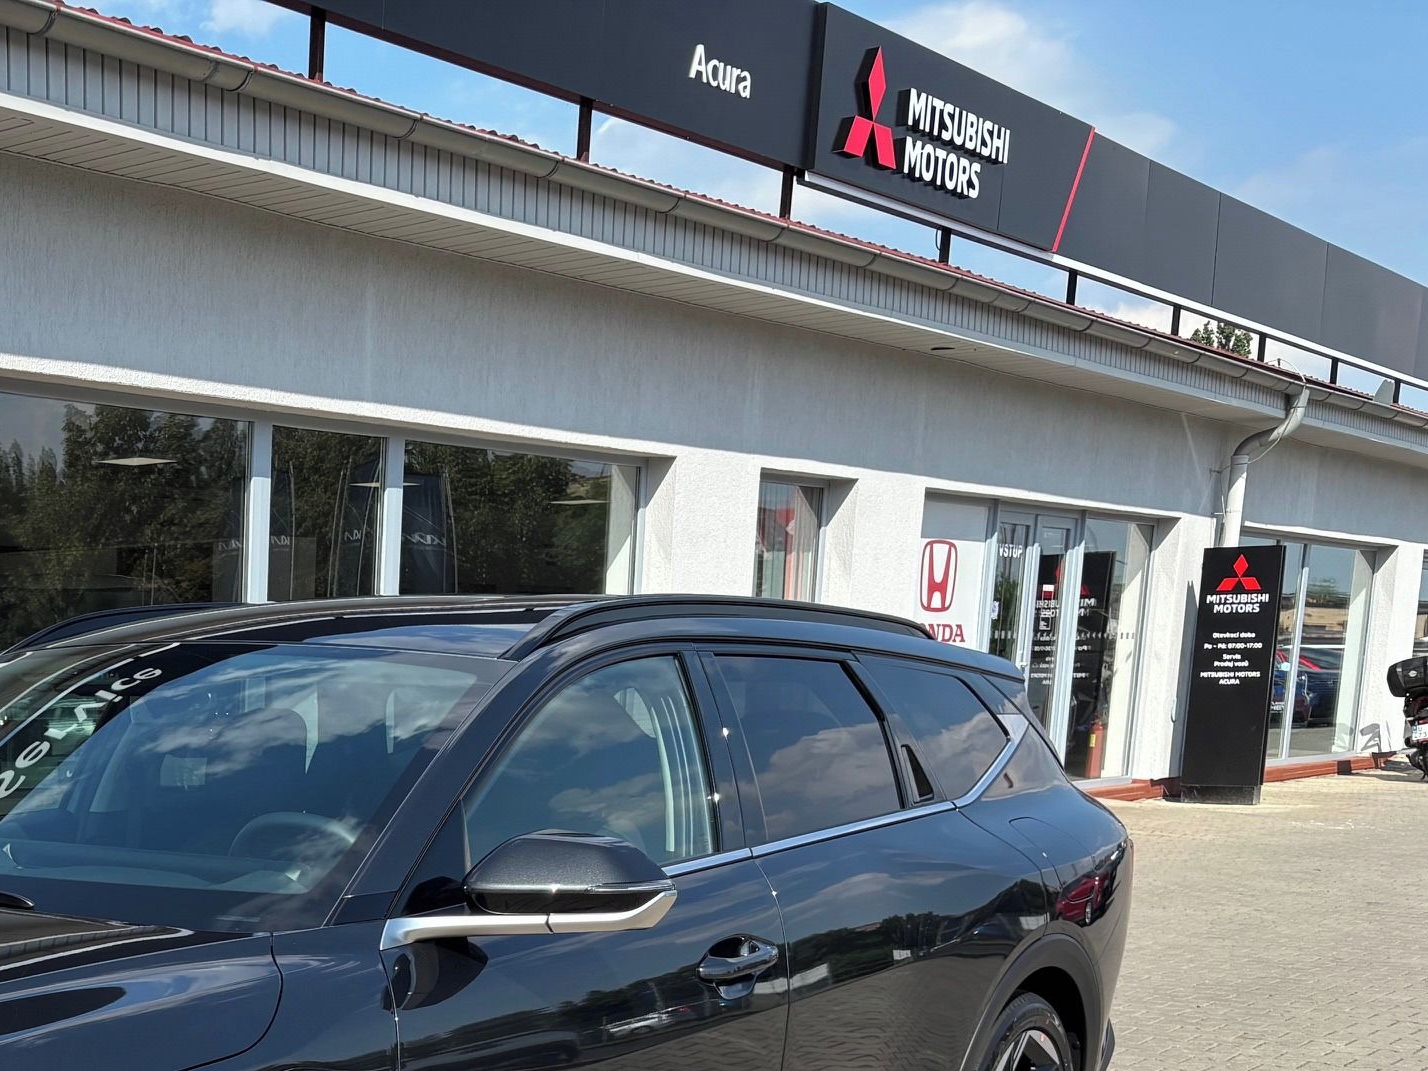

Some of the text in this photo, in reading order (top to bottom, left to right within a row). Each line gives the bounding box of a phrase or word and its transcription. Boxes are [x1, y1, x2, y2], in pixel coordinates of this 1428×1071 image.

[689, 44, 751, 99] Acura
[907, 87, 1011, 164] MITSUBISHI
[903, 136, 981, 199] MOTORS
[999, 543, 1023, 559] VSTUP
[1206, 593, 1270, 604] MITSUBISHI
[1213, 603, 1260, 614] MOTORS
[921, 623, 966, 643] NDA
